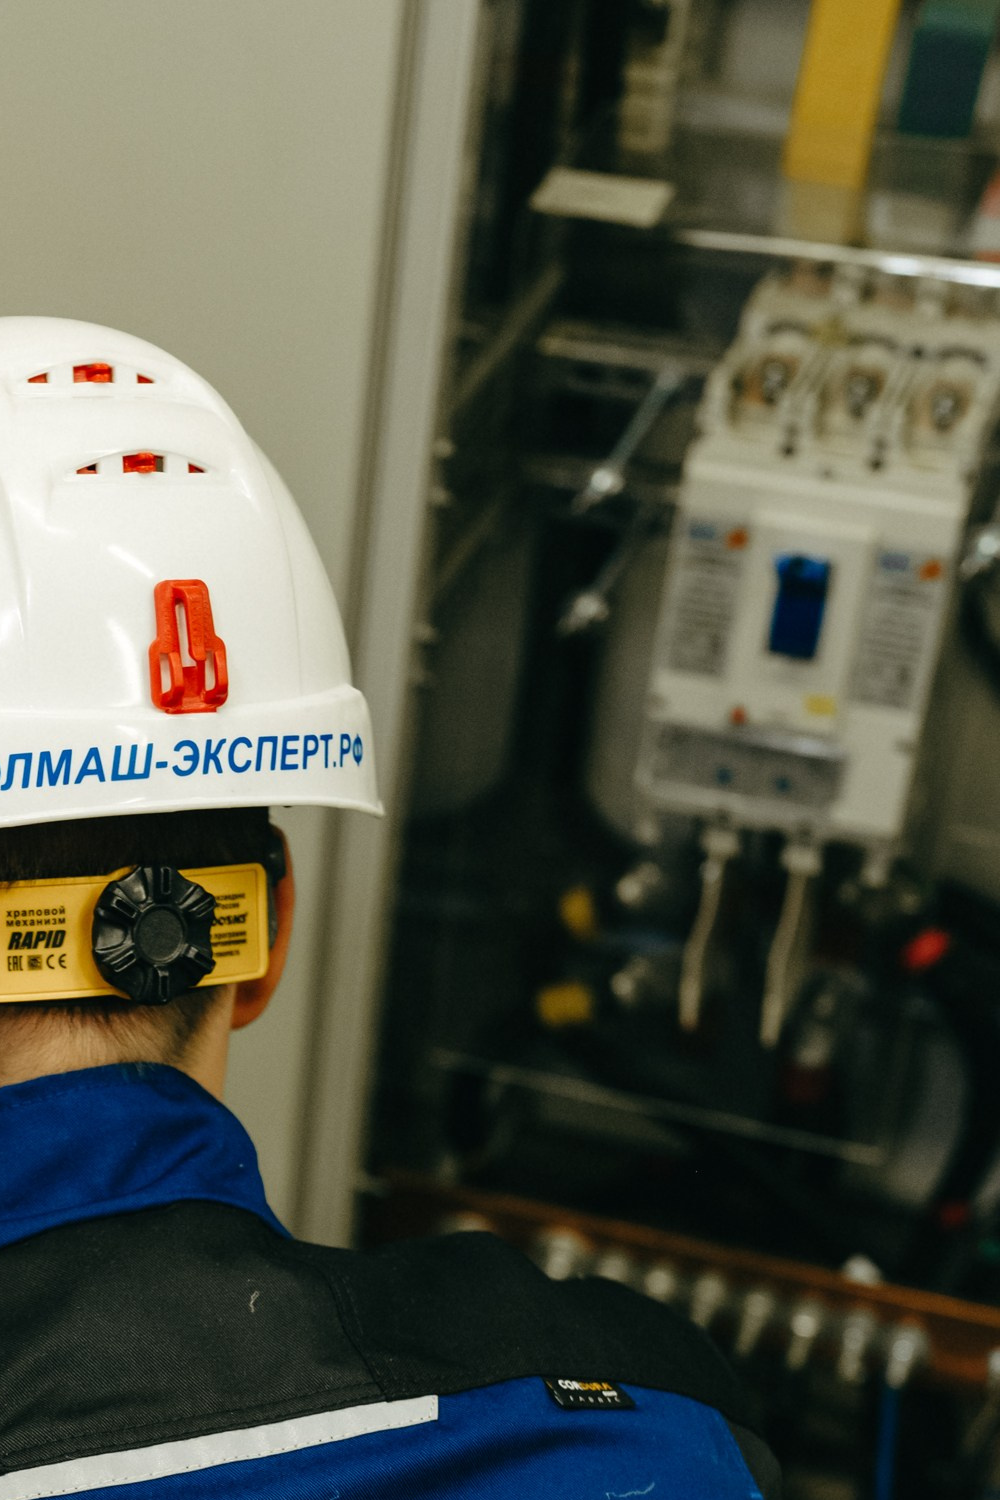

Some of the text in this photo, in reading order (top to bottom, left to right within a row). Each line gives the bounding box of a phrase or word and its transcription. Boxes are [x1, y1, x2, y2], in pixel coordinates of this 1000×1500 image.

[6, 905, 66, 919] храповой
[6, 918, 66, 927] механизм
[8, 930, 67, 950] RAPID
[558, 1379, 613, 1391] CORDURA
